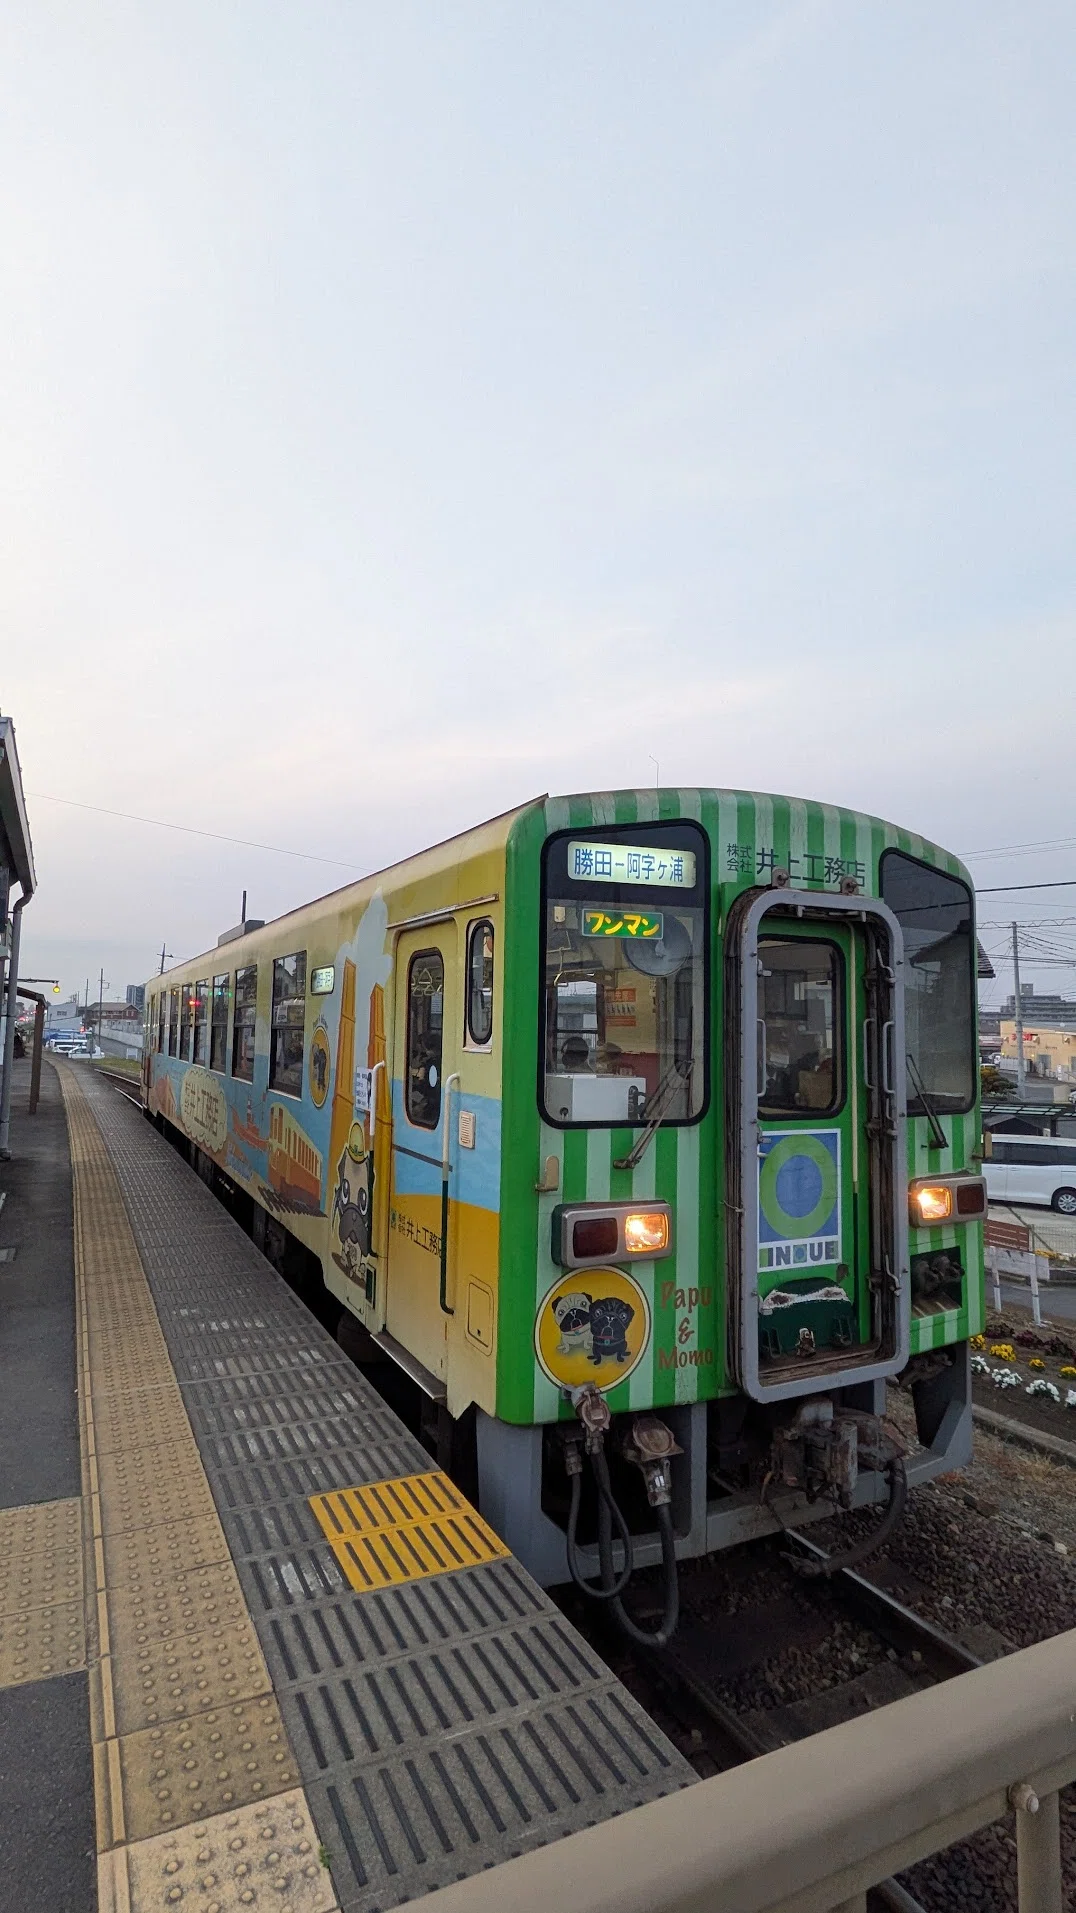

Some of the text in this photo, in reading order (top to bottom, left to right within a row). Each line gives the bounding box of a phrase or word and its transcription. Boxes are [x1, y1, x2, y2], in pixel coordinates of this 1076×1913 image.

[585, 912, 660, 937] ワンマン
[767, 1240, 839, 1267] INOUE
[661, 1280, 713, 1314] Papu
[677, 1316, 695, 1345] &
[657, 1345, 714, 1371] Momo
